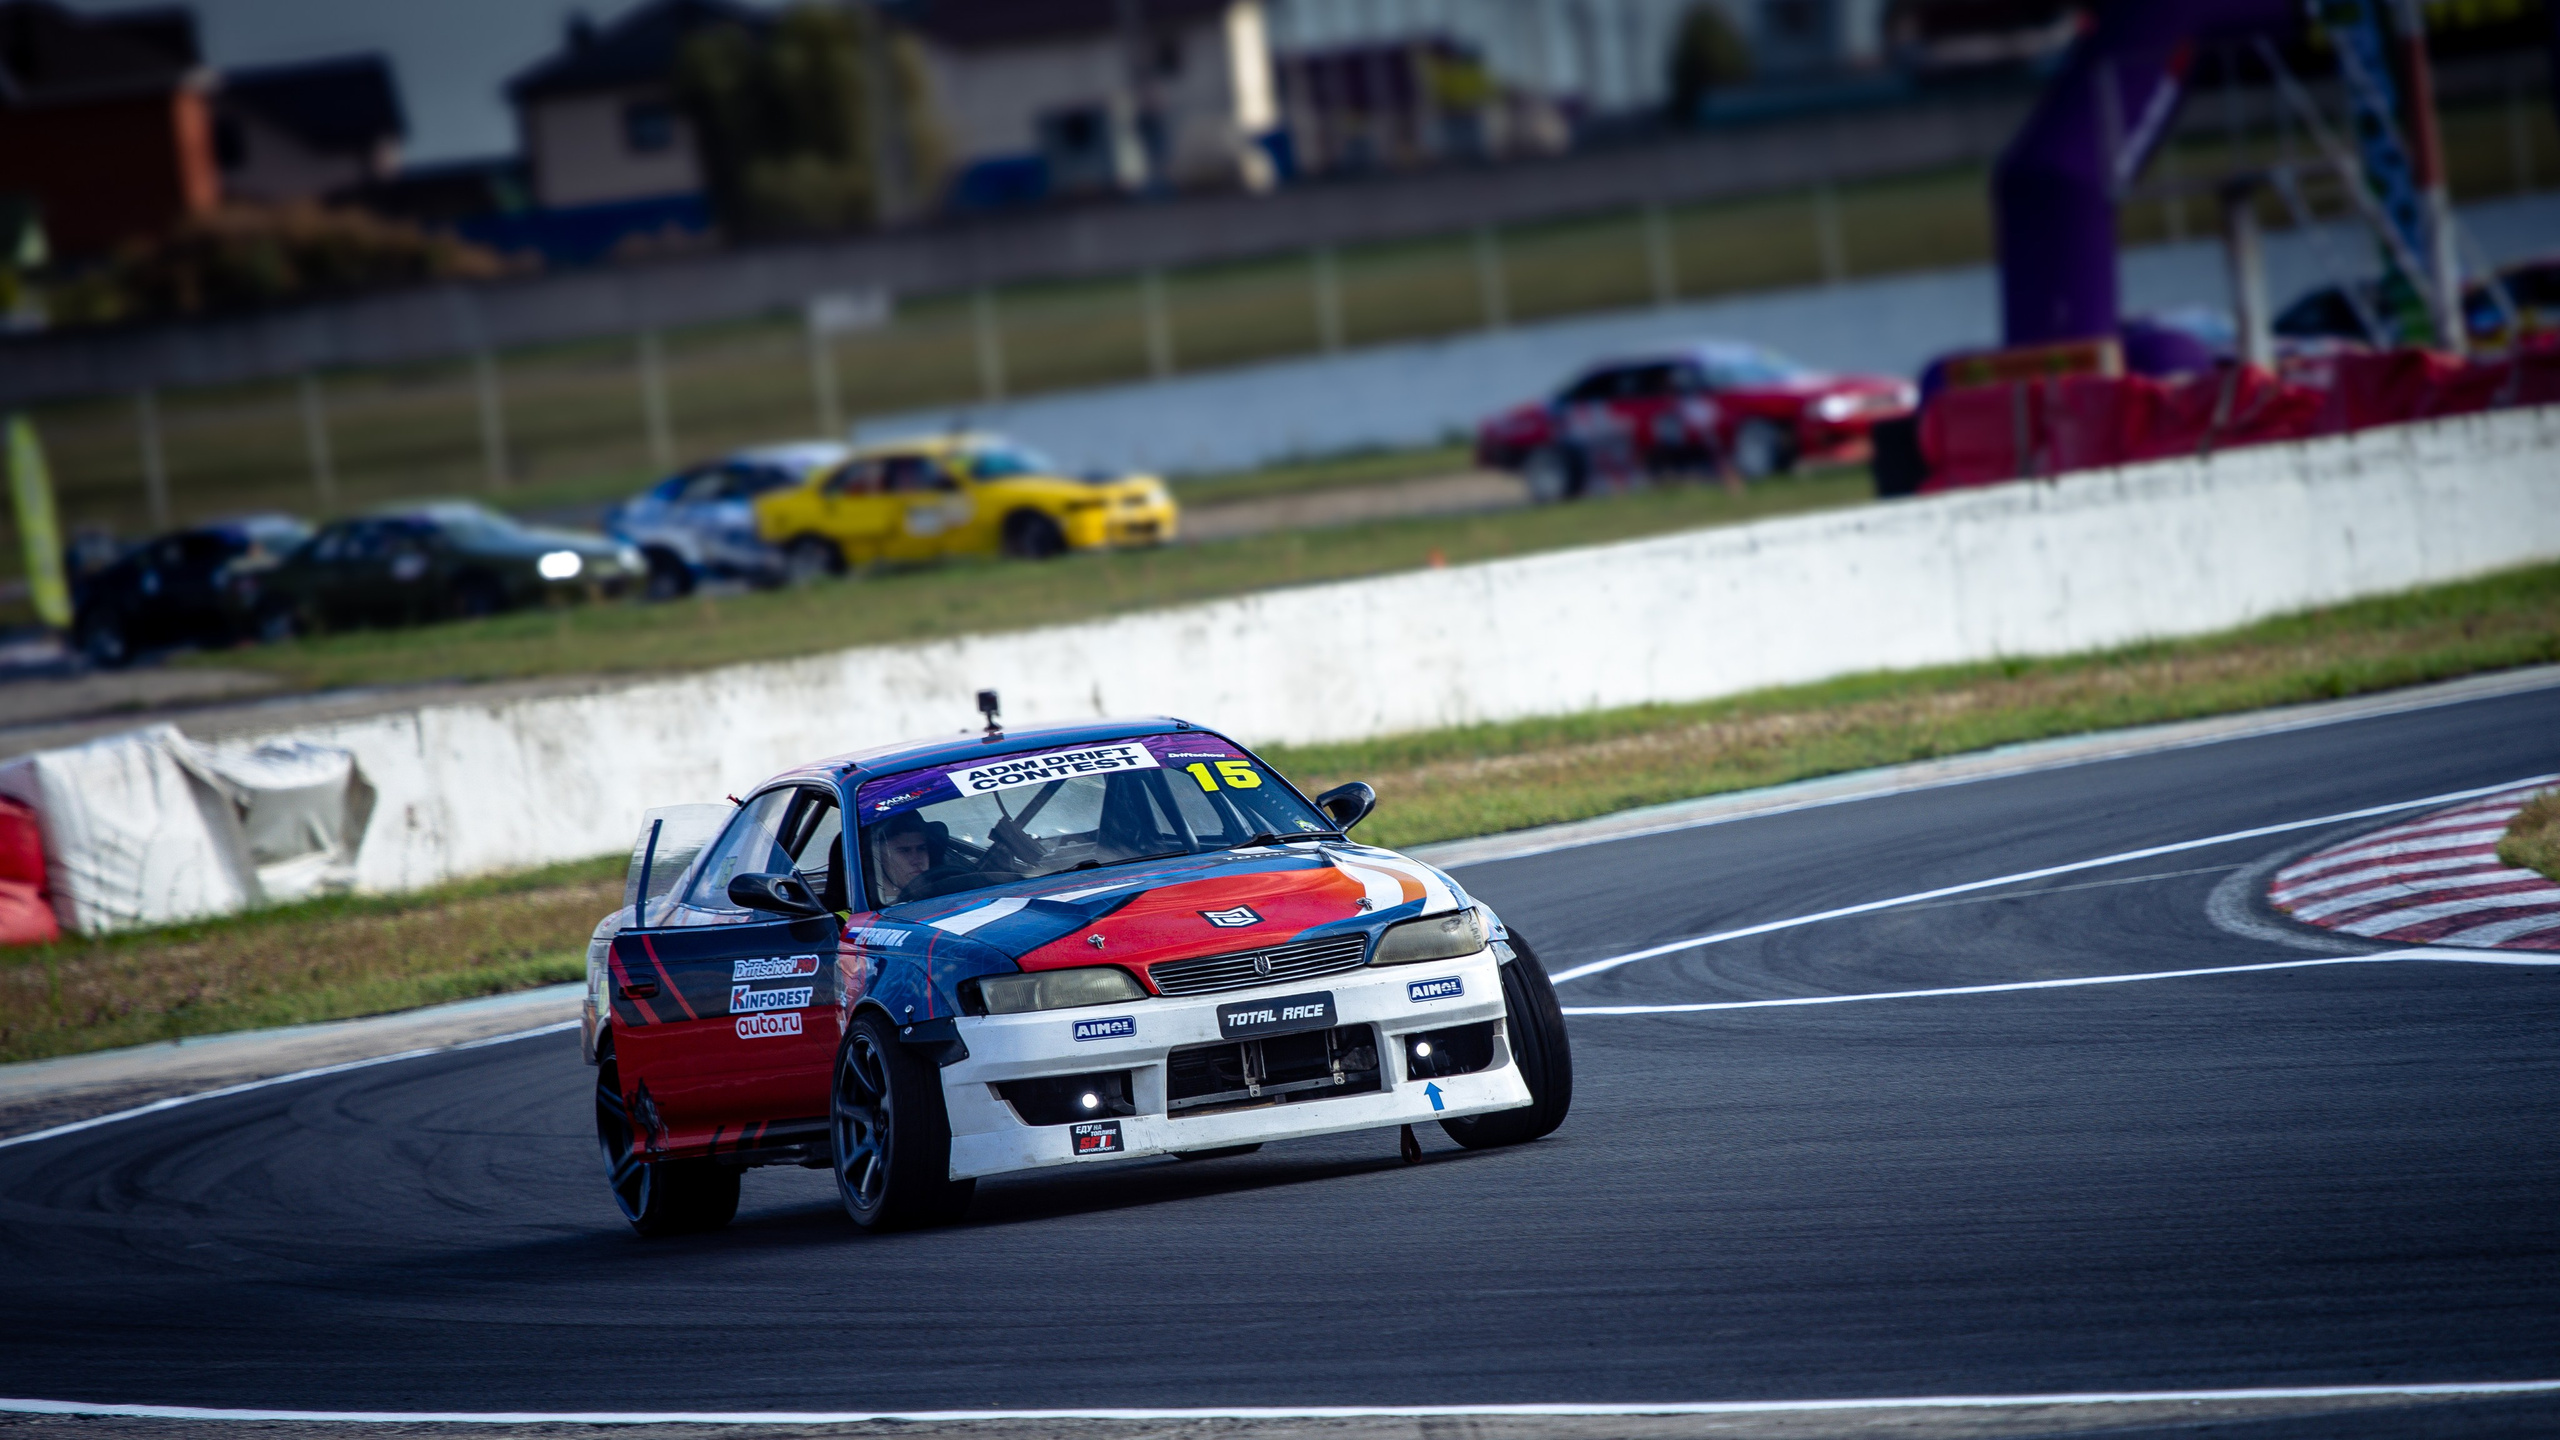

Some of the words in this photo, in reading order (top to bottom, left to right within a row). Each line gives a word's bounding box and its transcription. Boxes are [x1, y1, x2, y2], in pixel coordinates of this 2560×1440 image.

[968, 760, 1039, 782] ADM
[1042, 746, 1132, 767] DRIFT
[972, 755, 1139, 791] CONTEST
[1185, 760, 1263, 792] 15
[1411, 980, 1461, 999] AIMOL
[1227, 1009, 1277, 1027] TOTAL
[1282, 1003, 1325, 1020] RACE
[737, 1016, 801, 1036] auto.ru
[1076, 1020, 1133, 1037] AIMOL
[1075, 1124, 1093, 1134] ЕДУ
[1079, 1146, 1116, 1154] MOTORSPORT
